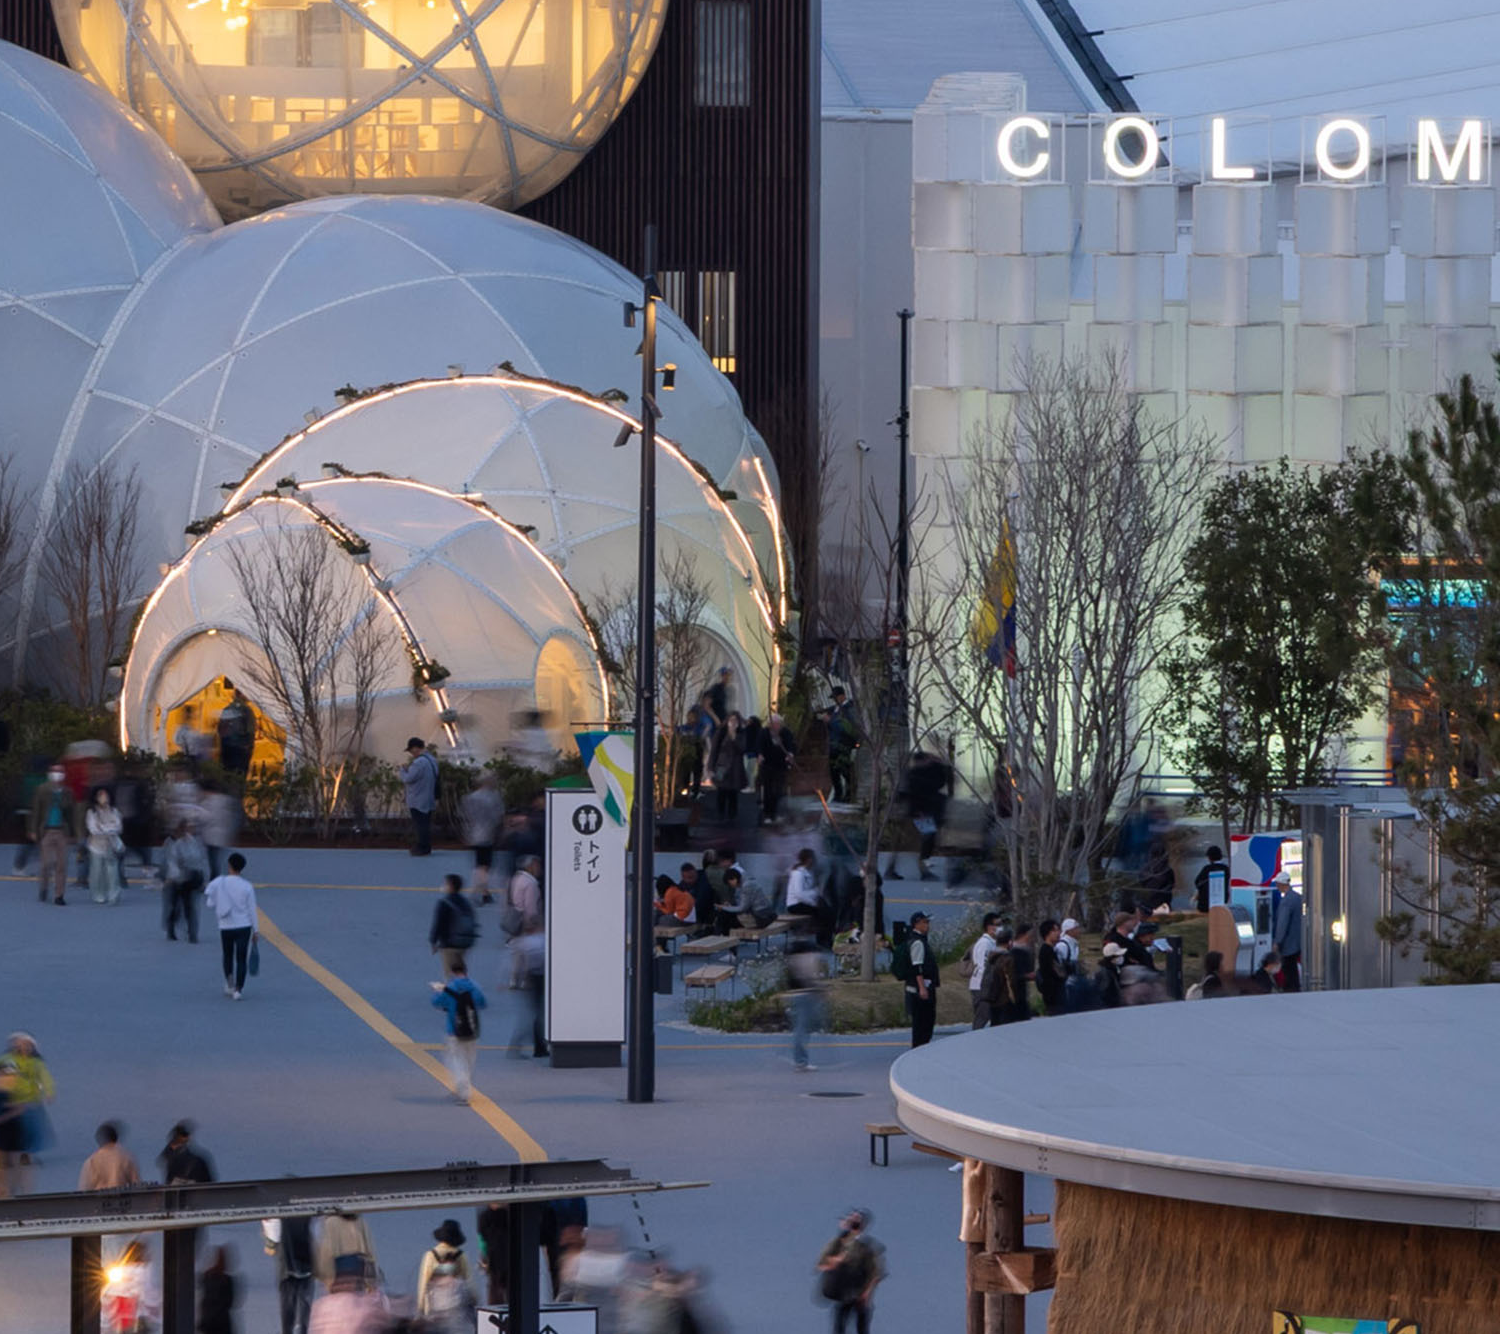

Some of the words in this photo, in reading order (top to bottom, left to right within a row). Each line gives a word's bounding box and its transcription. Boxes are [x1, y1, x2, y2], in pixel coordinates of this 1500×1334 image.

[997, 117, 1482, 182] COLOM
[574, 841, 582, 872] Toilets
[587, 840, 600, 883] トイレ
